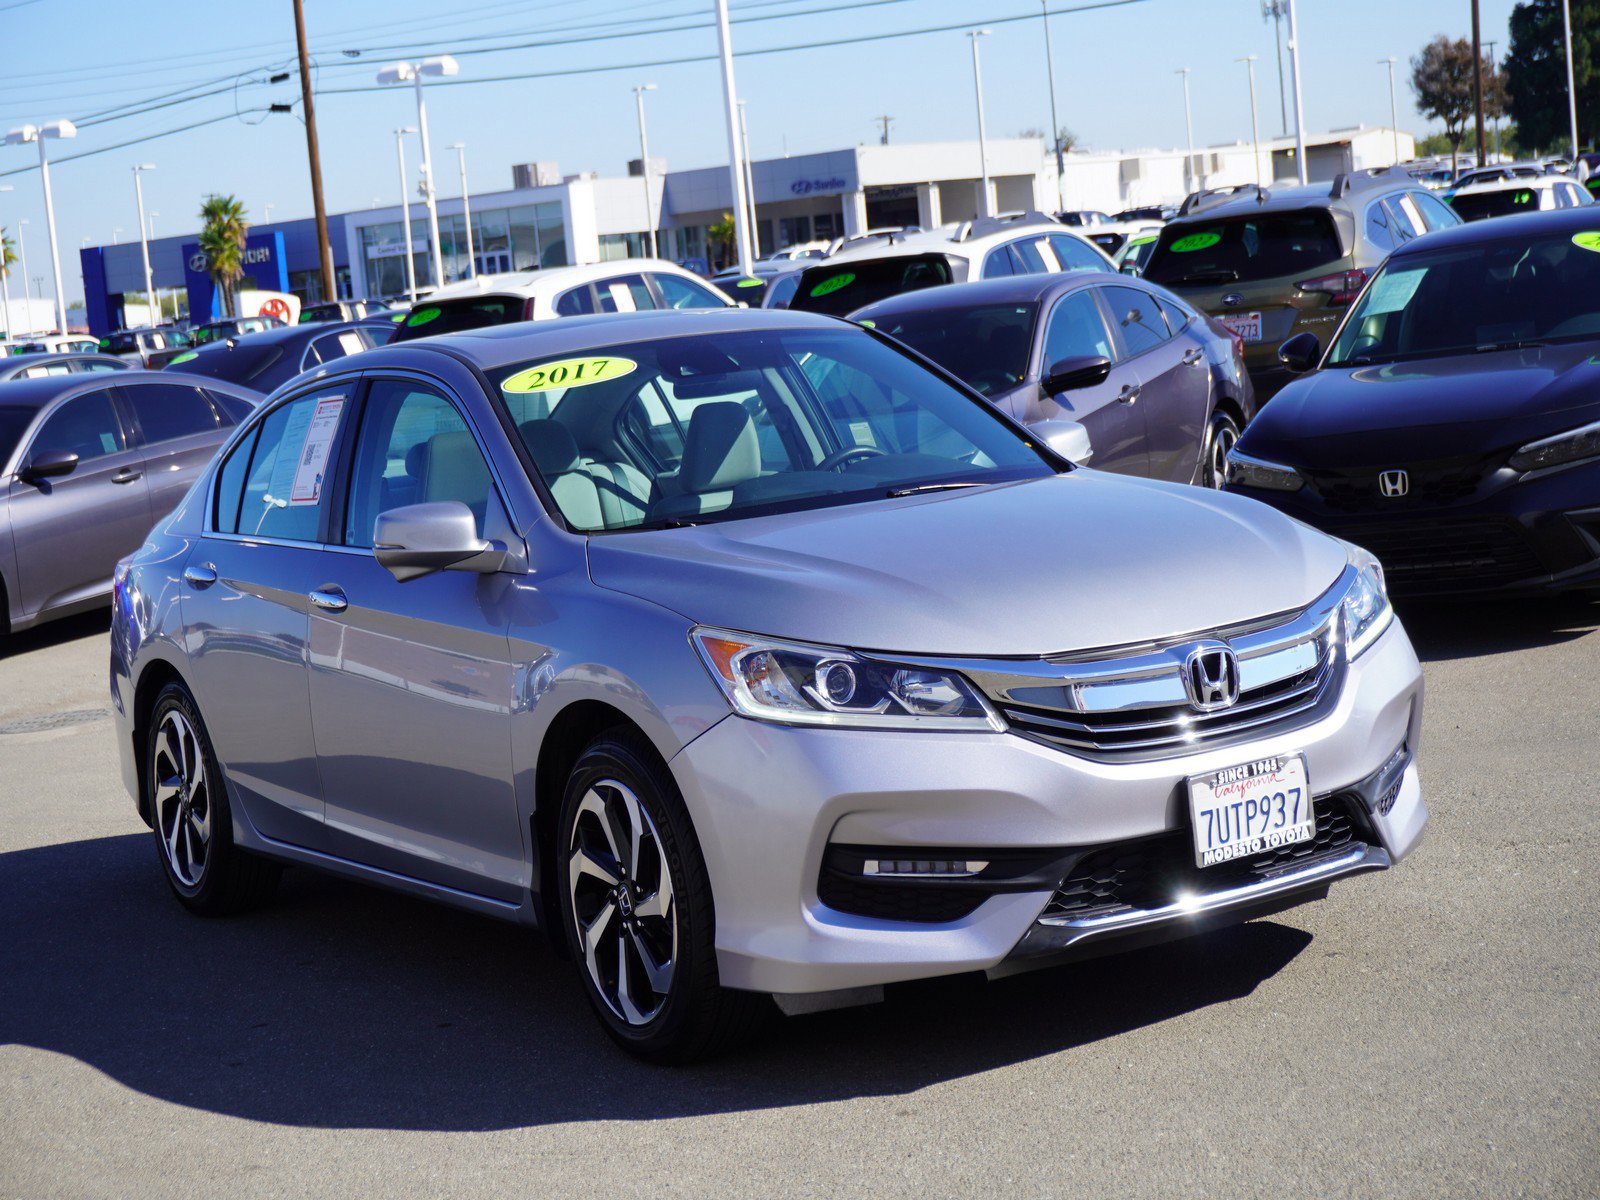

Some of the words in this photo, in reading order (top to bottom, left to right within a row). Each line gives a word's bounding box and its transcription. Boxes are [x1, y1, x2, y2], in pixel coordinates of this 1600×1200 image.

[527, 360, 609, 390] 2017
[1215, 772, 1285, 799] California
[1217, 764, 1249, 783] SINCE
[1200, 787, 1301, 849] 7UTP937
[1203, 839, 1262, 867] MODESTO
[1263, 825, 1311, 848] TOYOTA
